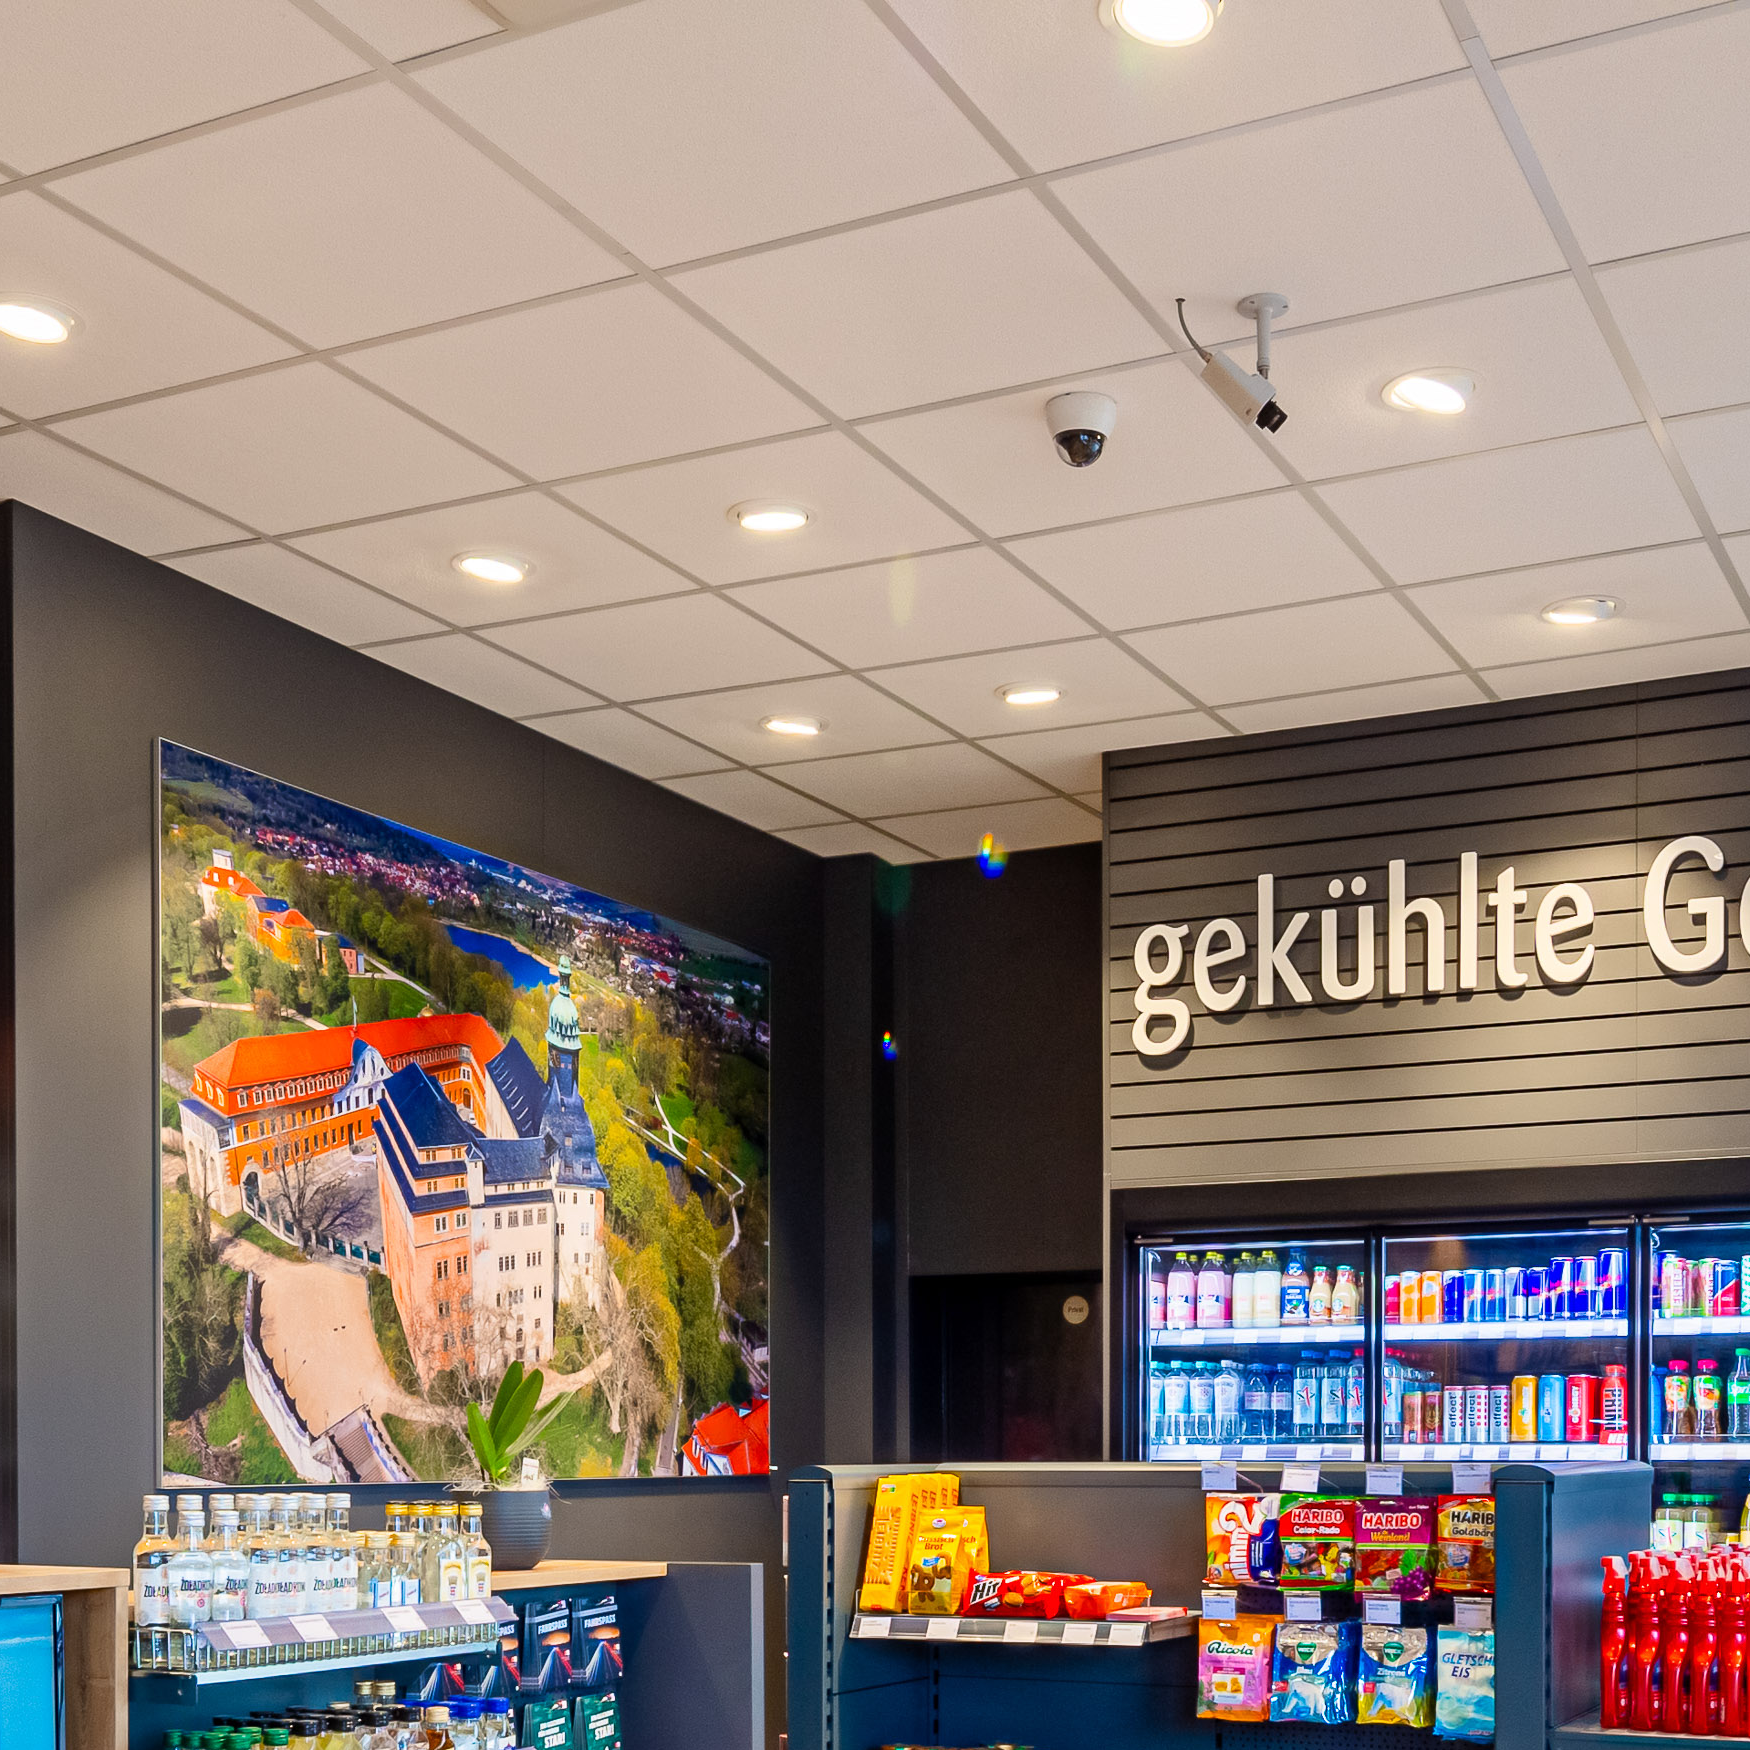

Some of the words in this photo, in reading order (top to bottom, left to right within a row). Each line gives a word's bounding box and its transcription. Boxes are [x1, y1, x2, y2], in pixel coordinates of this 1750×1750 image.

[1131, 850, 1596, 1055] gekühlte
[1291, 1509, 1344, 1524] HARIBO
[1362, 1513, 1421, 1530] HARIBO
[924, 1542, 944, 1551] Brot
[973, 1578, 999, 1604] Hit
[1207, 1641, 1254, 1656] Ricola
[1451, 1667, 1470, 1678] EIS
